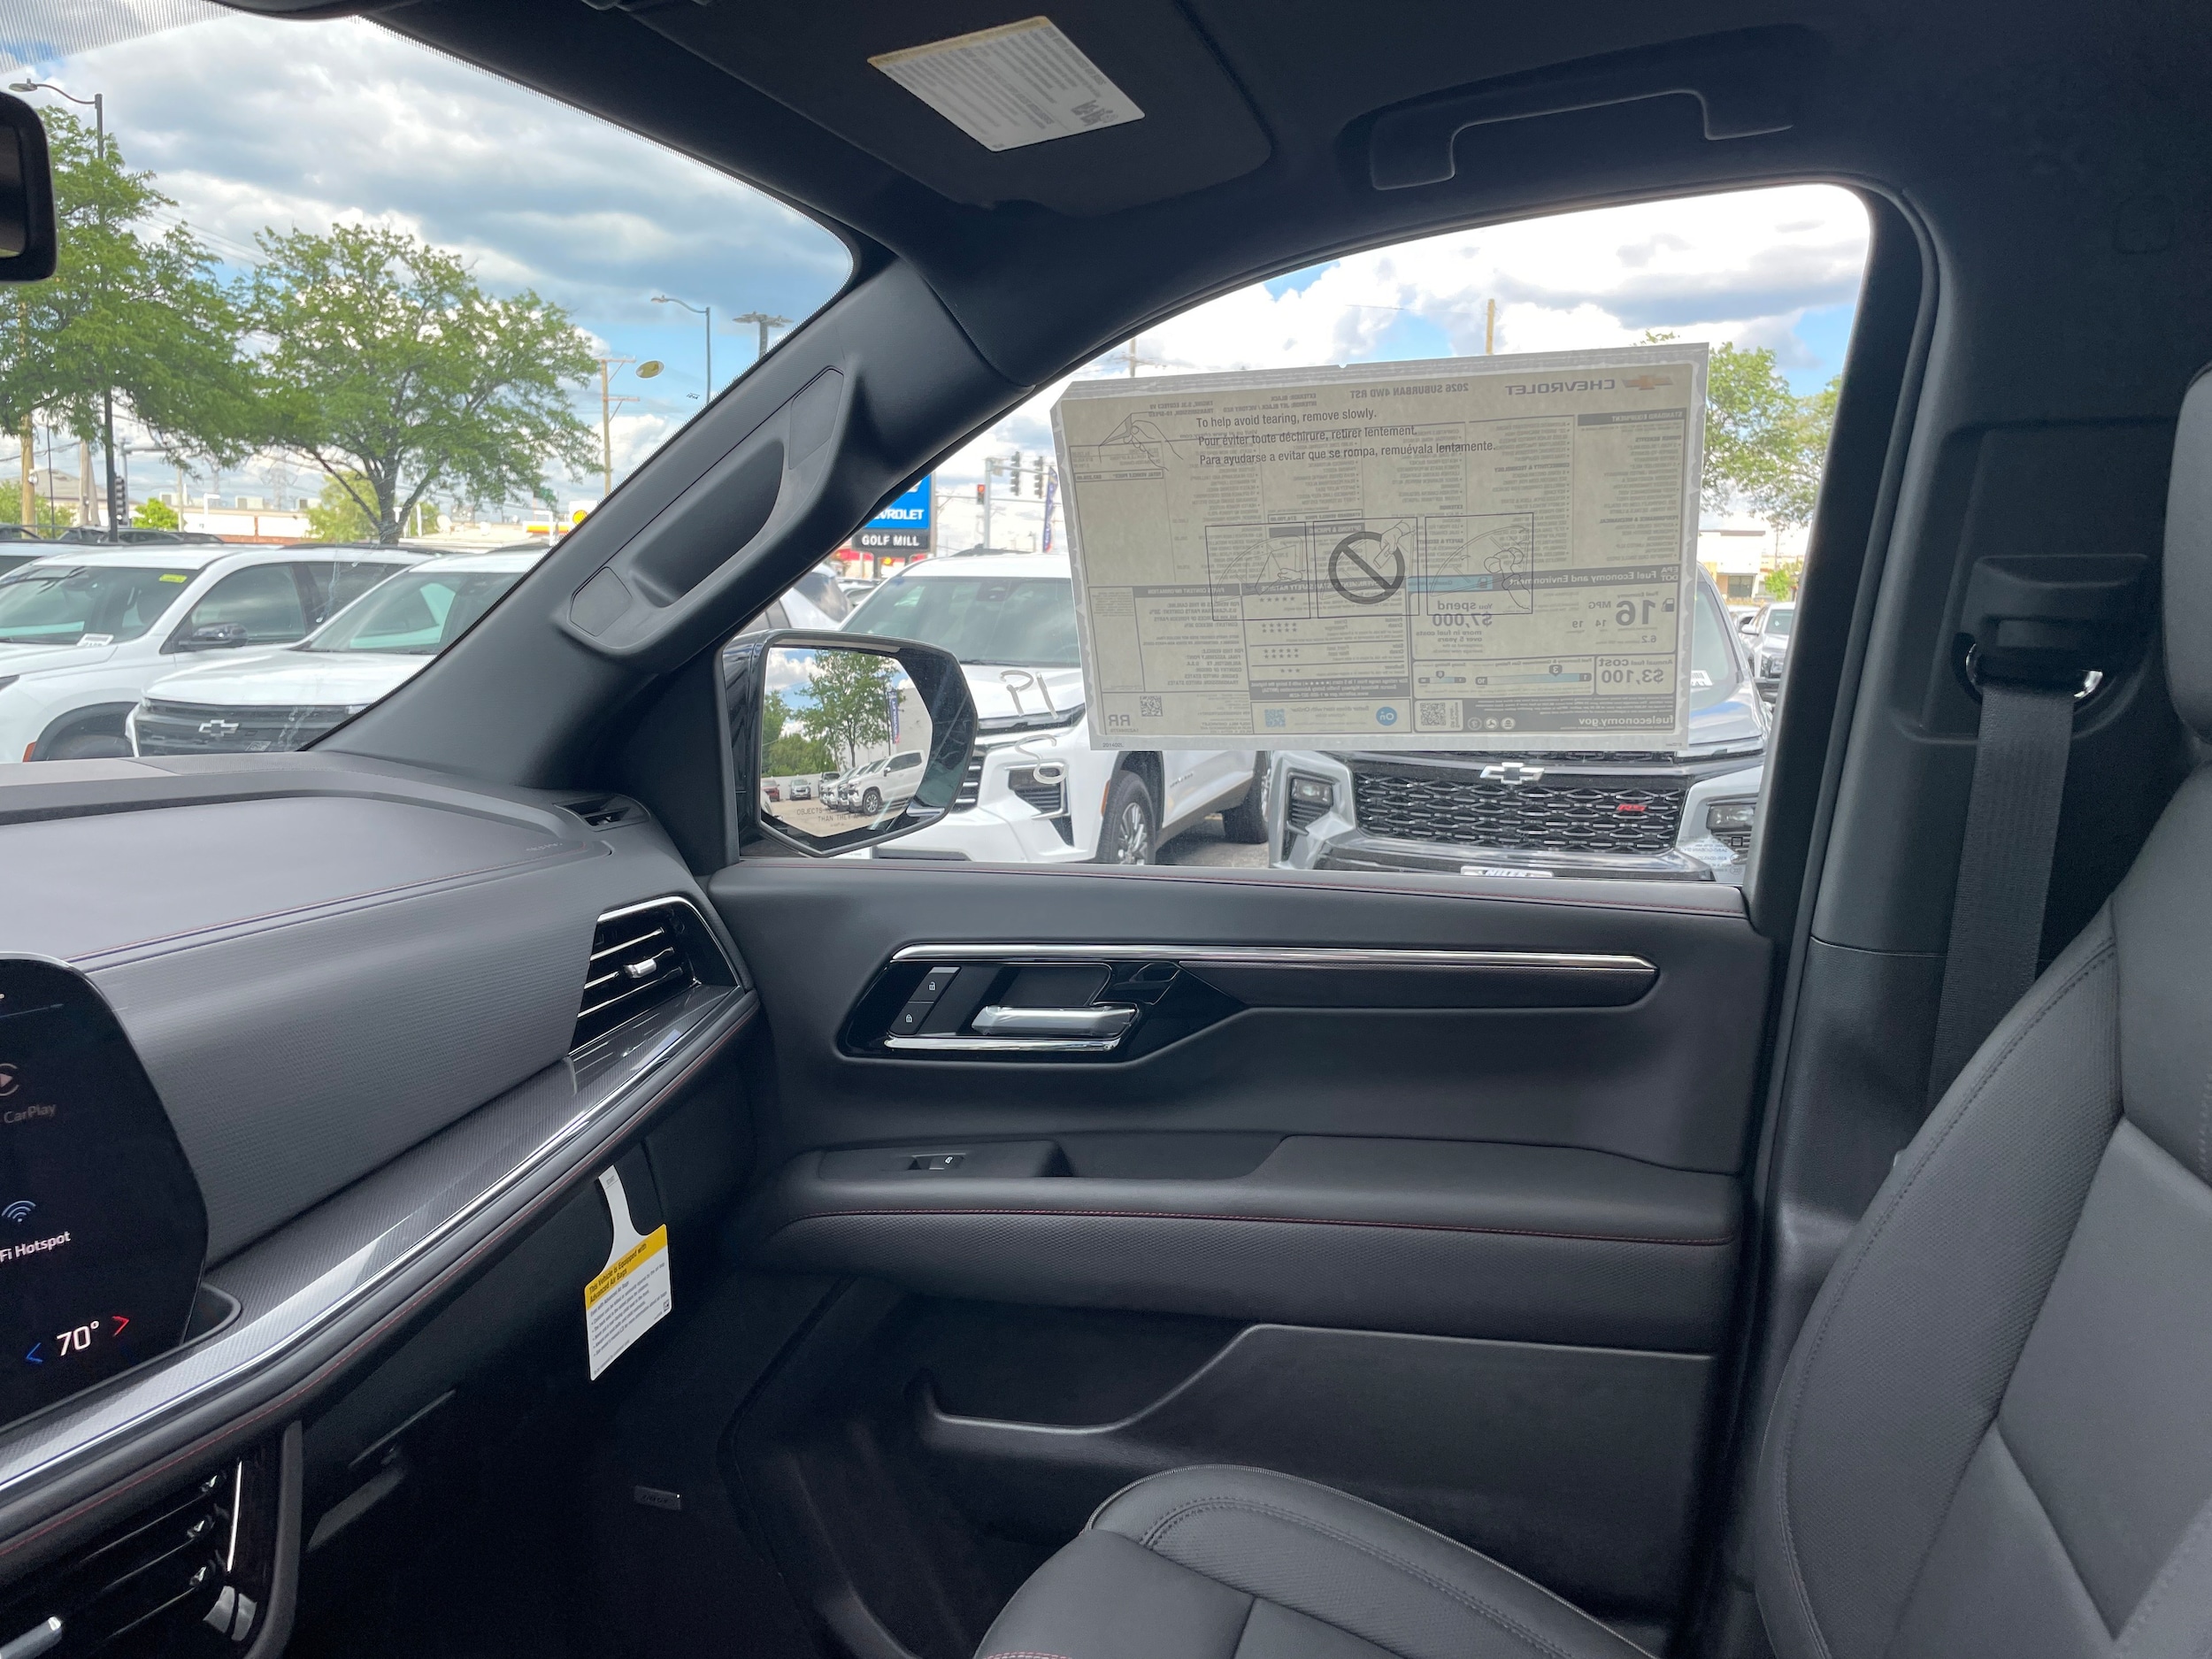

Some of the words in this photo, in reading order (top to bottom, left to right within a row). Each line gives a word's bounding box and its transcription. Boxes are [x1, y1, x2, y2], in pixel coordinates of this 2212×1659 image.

[1196, 419, 1208, 428] To
[1210, 416, 1231, 430] help
[1234, 415, 1260, 426] avoid
[1262, 412, 1300, 426] tearing,
[1302, 411, 1339, 422] remove
[1342, 407, 1377, 421] slowly.
[1199, 436, 1220, 446] Pour
[1222, 434, 1249, 445] éviter
[1251, 433, 1276, 444] toute
[1279, 430, 1329, 444] déchirure,
[1332, 428, 1362, 439] retirer
[1364, 426, 1417, 438] lentement.
[1200, 454, 1221, 465] Para
[1224, 452, 1267, 466] ayudarse
[1279, 450, 1306, 461] evitar
[1308, 450, 1326, 462] que
[1329, 450, 1341, 458] se
[1344, 448, 1378, 461] rompa,
[1381, 444, 1433, 457] remuévala
[1436, 441, 1496, 453] lentamente.
[874, 509, 925, 520] VROLET
[861, 535, 890, 546] GOLF
[893, 535, 920, 546] MILL
[797, 807, 823, 815] OBJECTS
[4, 1104, 57, 1123] CarPlay
[15, 1231, 71, 1257] Hotspot
[589, 1284, 598, 1294] This
[598, 1270, 613, 1286] Vehicle
[618, 1249, 637, 1269] Equipped
[637, 1243, 647, 1254] with
[590, 1284, 610, 1304] Advanced
[617, 1268, 627, 1281] Bags
